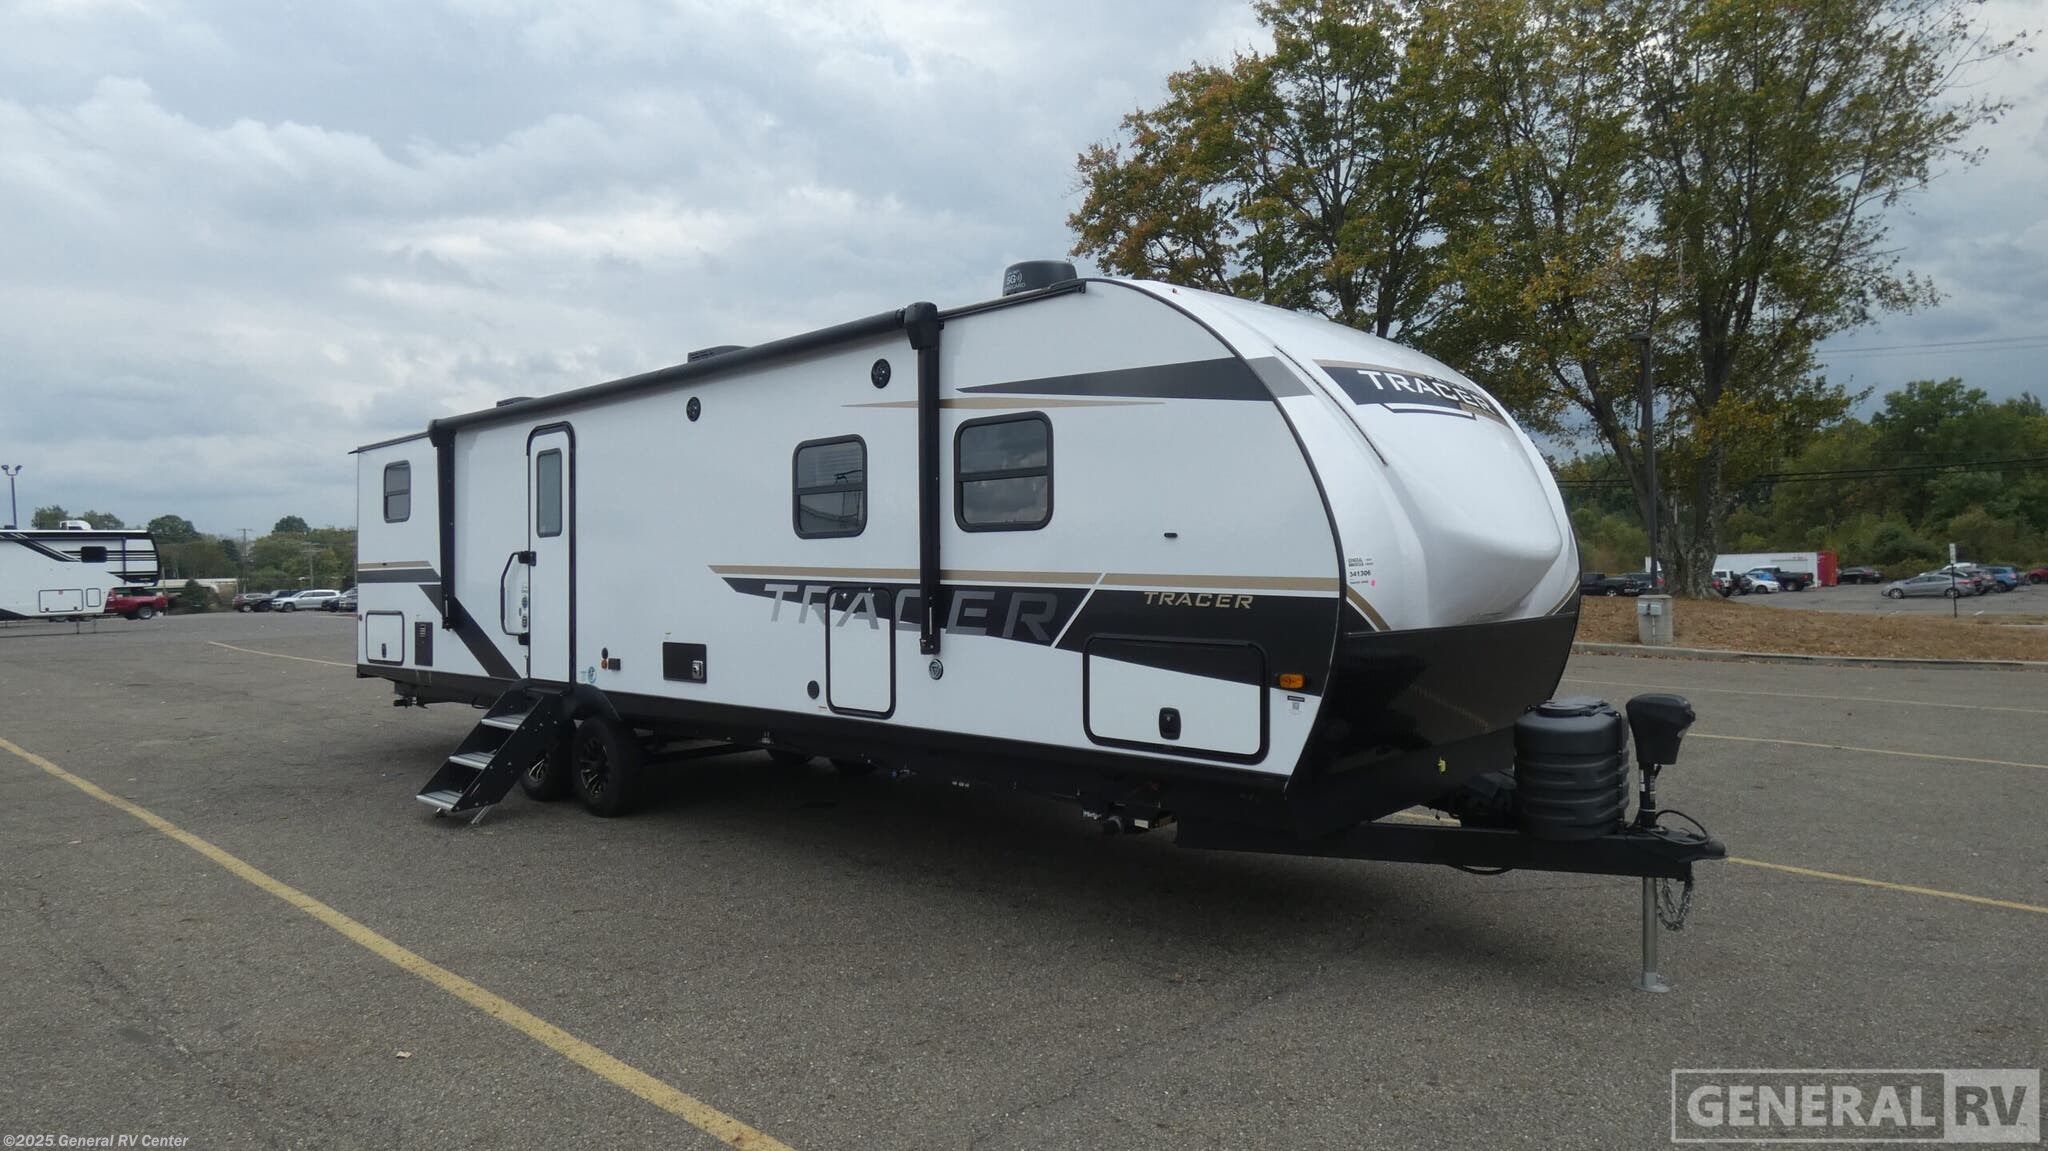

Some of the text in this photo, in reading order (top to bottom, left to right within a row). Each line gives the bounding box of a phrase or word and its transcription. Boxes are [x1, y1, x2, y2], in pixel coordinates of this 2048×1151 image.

[1357, 369, 1497, 415] TRACER
[764, 583, 1058, 642] TRACER
[1144, 591, 1254, 609] TRACER
